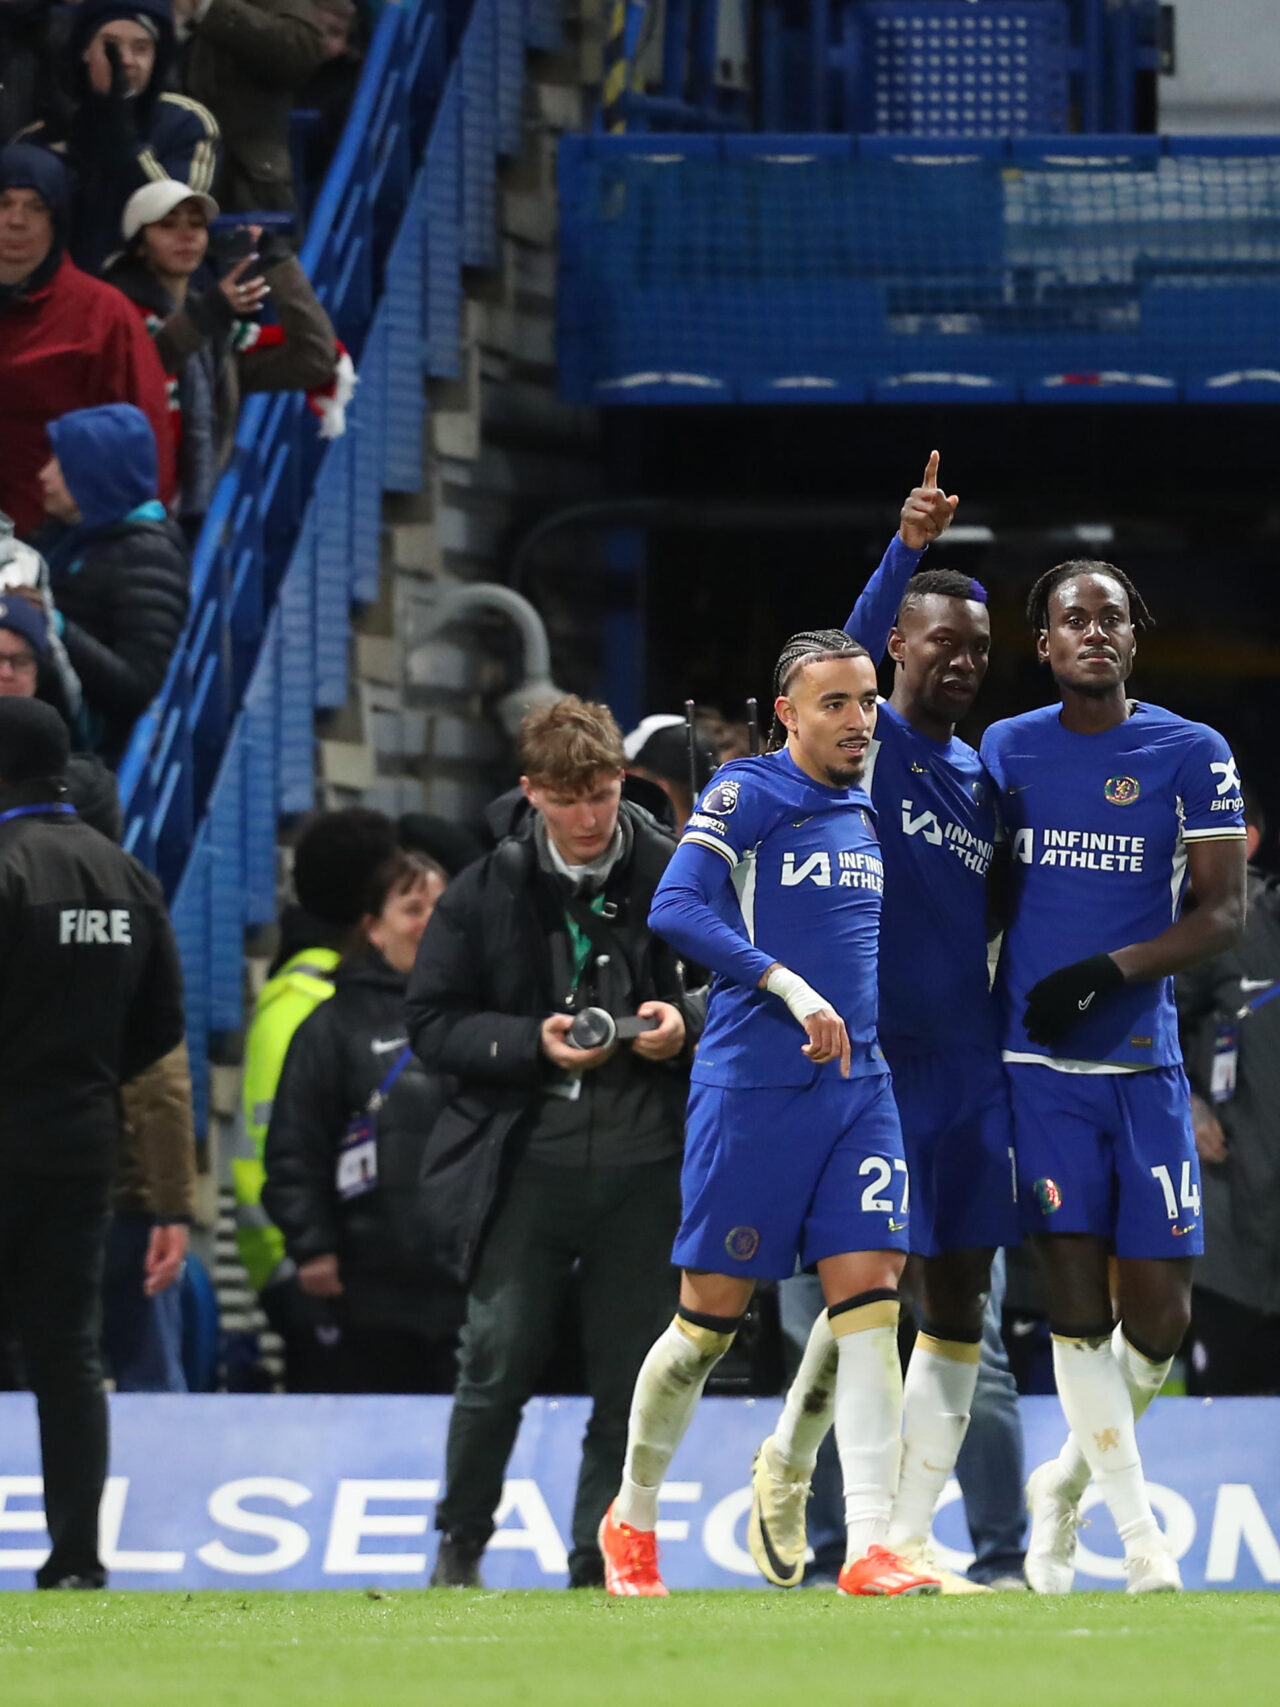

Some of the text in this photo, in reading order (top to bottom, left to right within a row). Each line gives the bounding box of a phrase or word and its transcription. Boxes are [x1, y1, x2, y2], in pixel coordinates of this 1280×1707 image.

[1043, 829, 1145, 854] INFINITE
[1040, 849, 1143, 873] ATHLETE
[60, 908, 132, 945] FIRE
[858, 1156, 910, 1214] 27
[1150, 1160, 1201, 1220] 14
